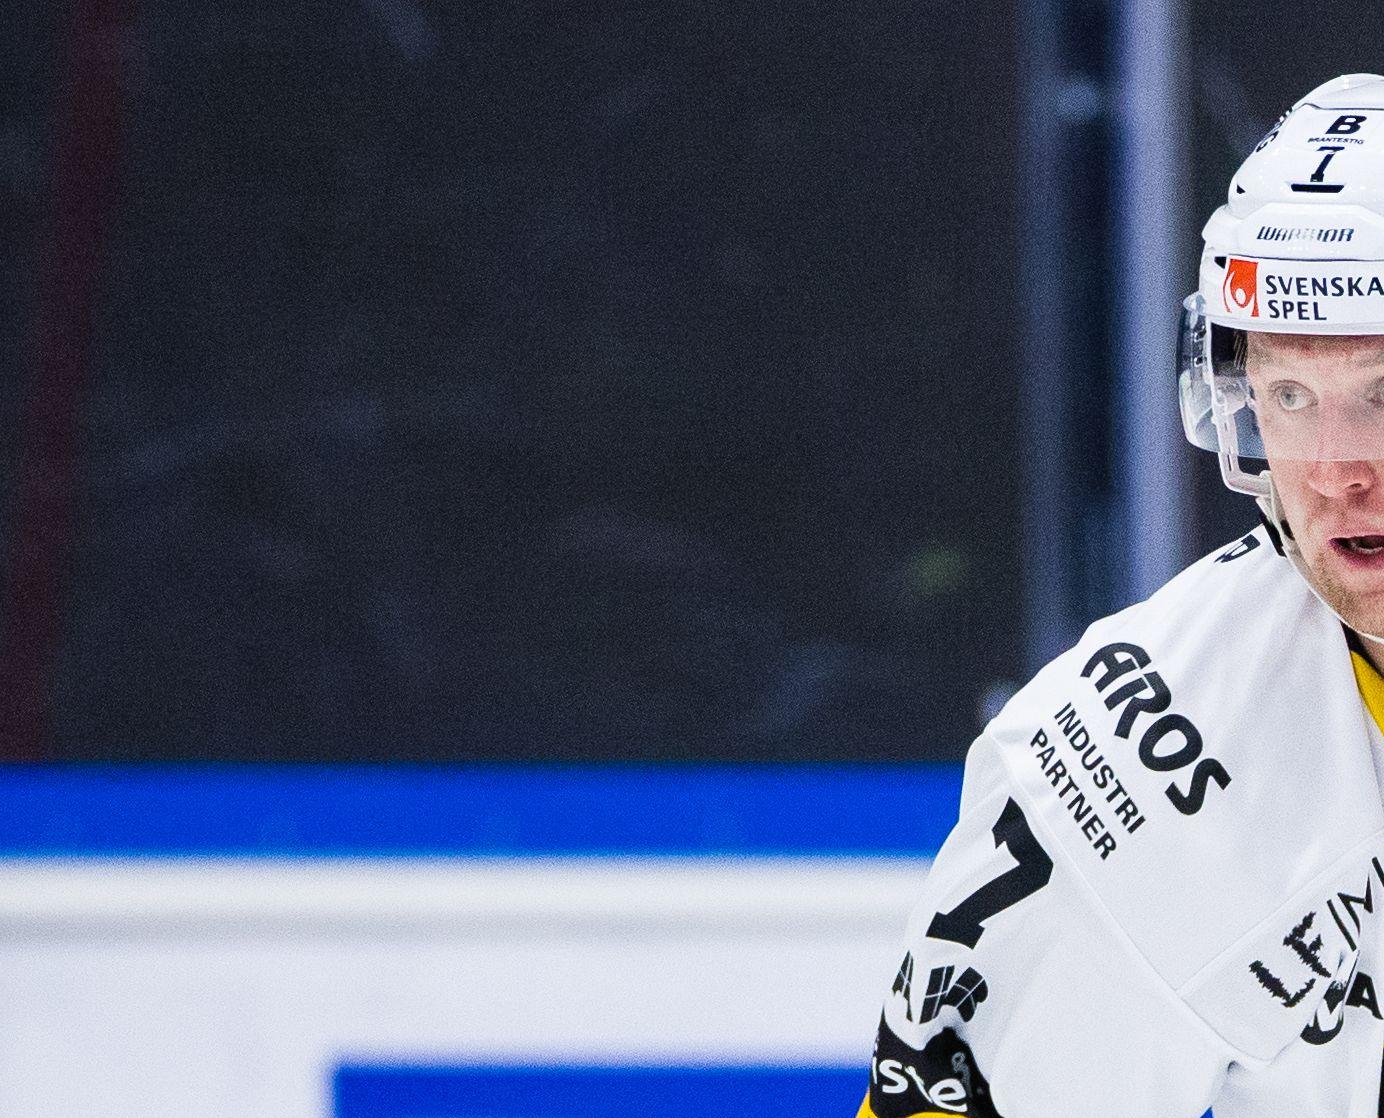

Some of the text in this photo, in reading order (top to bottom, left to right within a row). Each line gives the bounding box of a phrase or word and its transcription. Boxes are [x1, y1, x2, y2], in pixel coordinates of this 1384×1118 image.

[1267, 300, 1327, 321] SPEL
[1030, 728, 1117, 861] PARTNER
[1054, 702, 1146, 834] INDUSTRI
[926, 796, 1054, 950] 7
